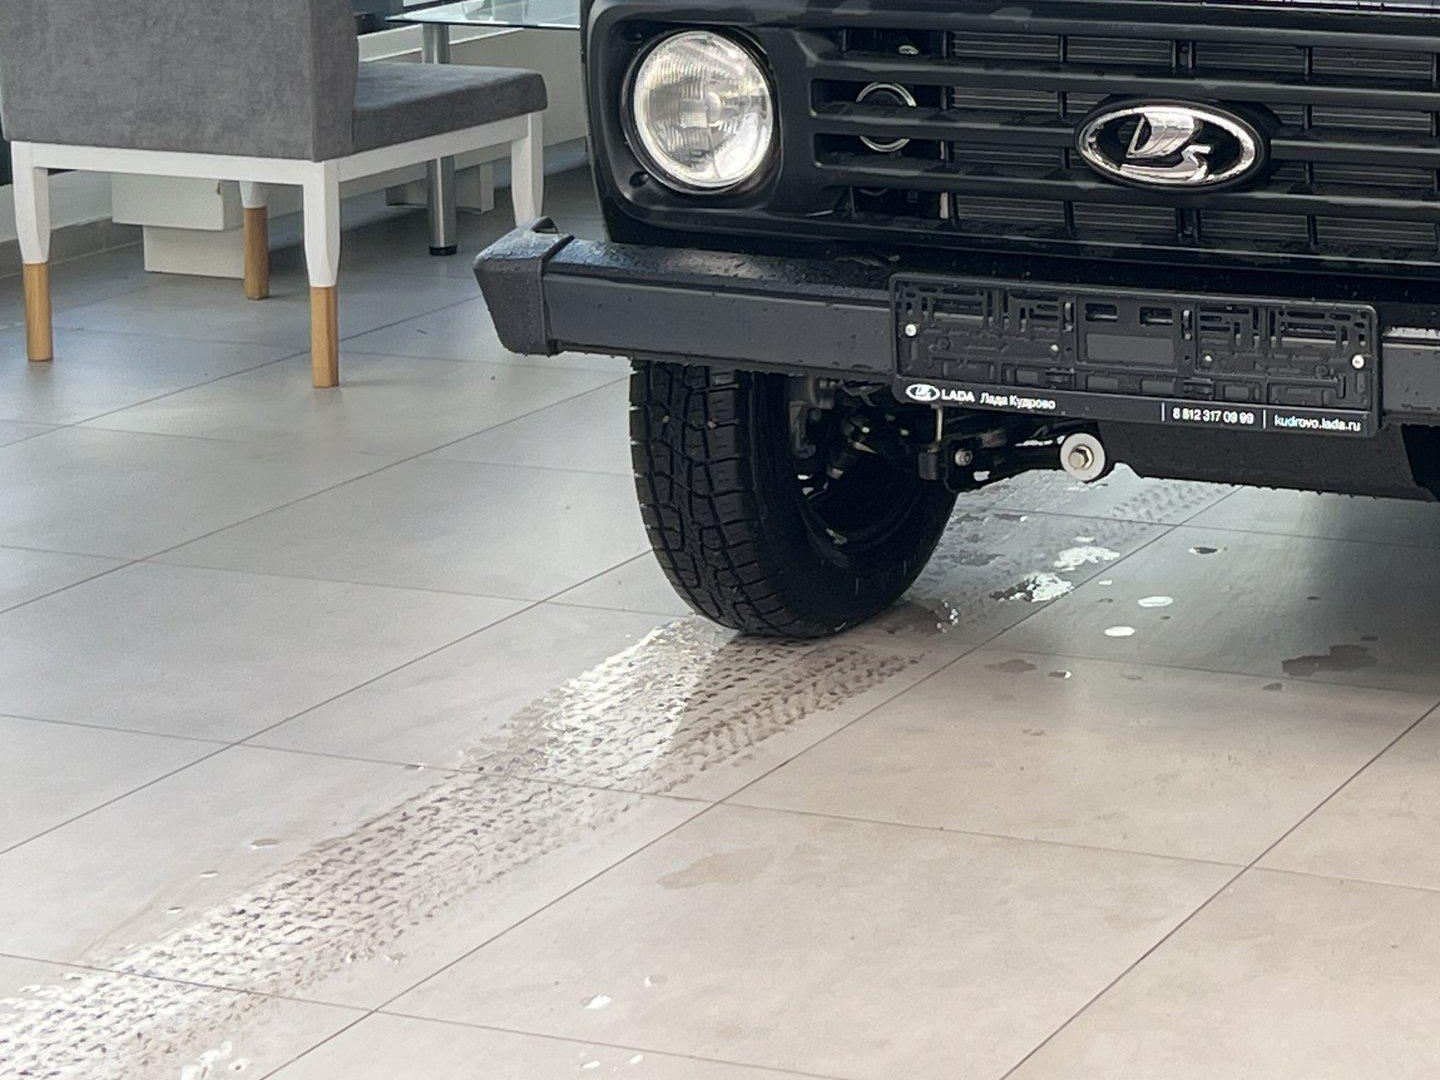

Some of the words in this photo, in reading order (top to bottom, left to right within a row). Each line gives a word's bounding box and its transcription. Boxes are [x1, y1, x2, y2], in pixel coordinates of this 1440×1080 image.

[941, 388, 975, 403] LADA
[980, 392, 1008, 406] Лада
[1009, 395, 1056, 410] Кудрово
[1172, 407, 1181, 420] 8
[1182, 407, 1201, 421] 812
[1202, 409, 1222, 422] 317
[1274, 414, 1361, 432] kudrovo.lada.ru
